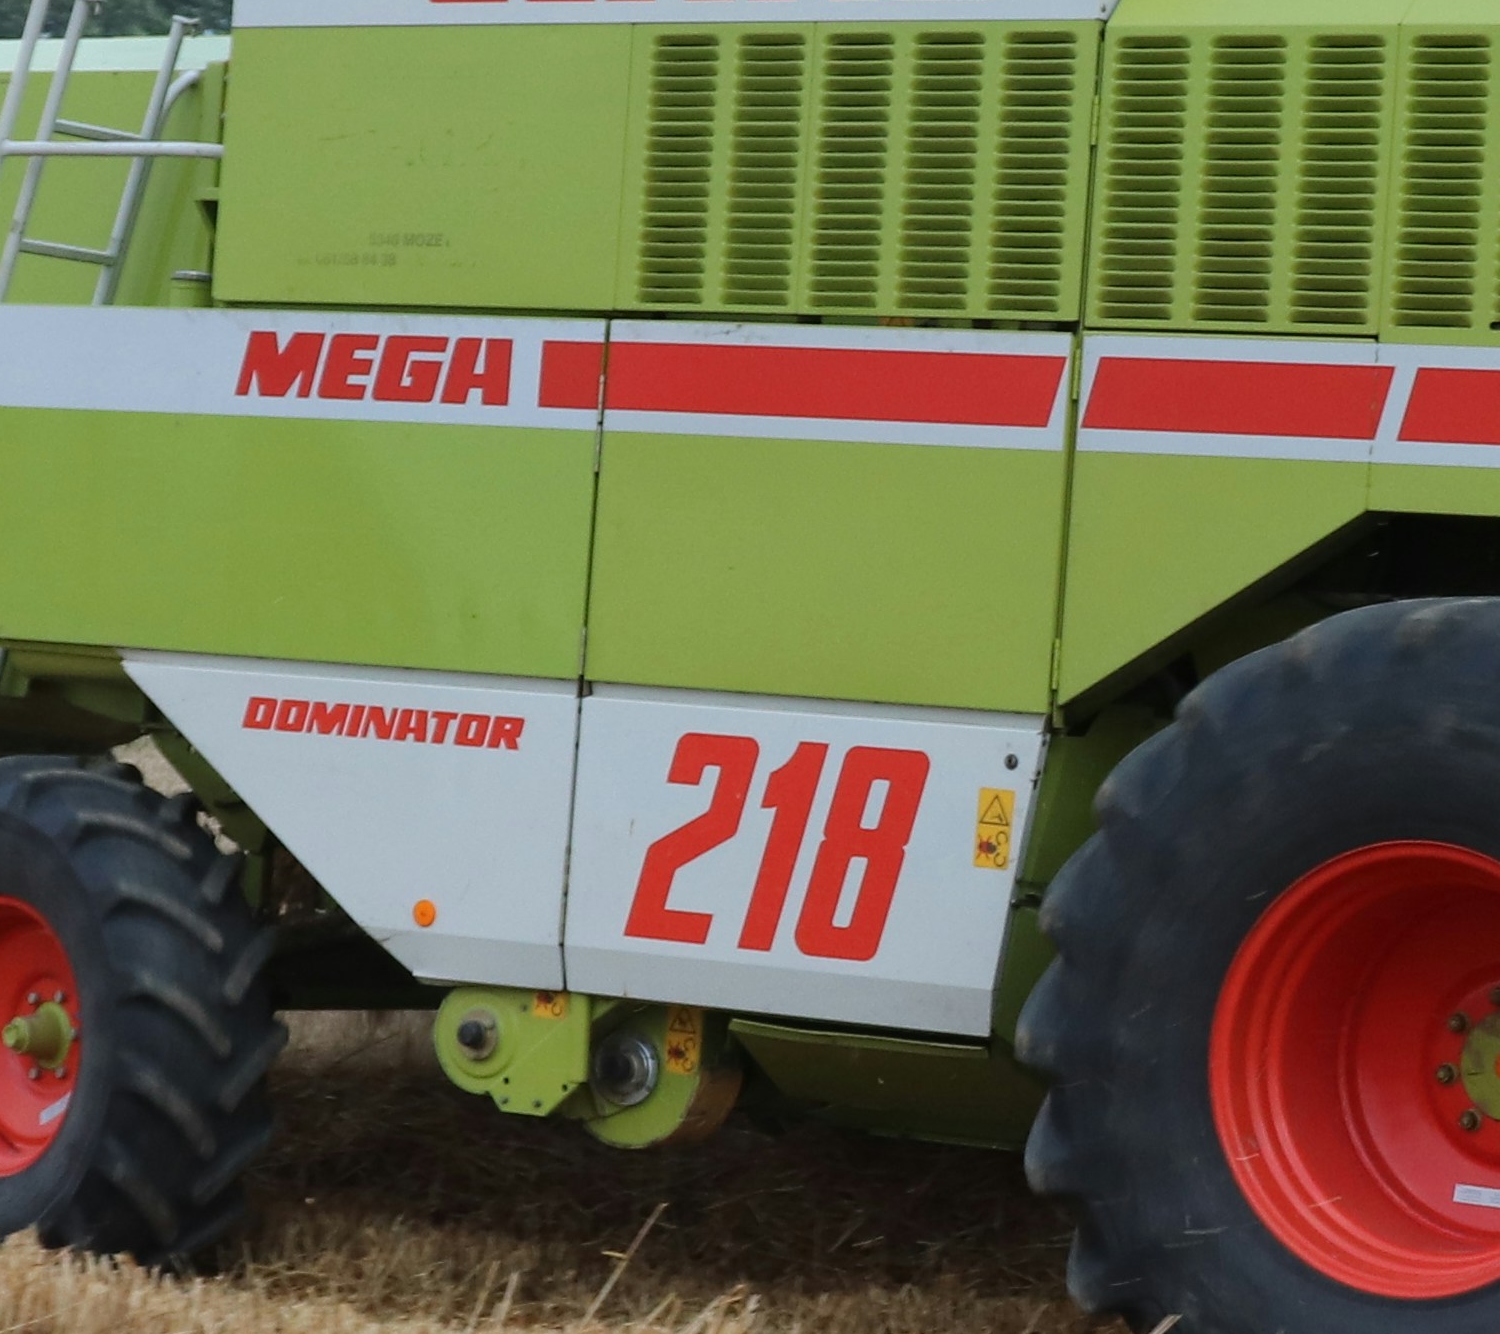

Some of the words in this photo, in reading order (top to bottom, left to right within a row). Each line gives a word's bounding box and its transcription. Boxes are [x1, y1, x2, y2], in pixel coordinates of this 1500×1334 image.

[234, 330, 513, 406] MEGA
[242, 696, 525, 750] DOMINATOR
[623, 732, 931, 962] 218
